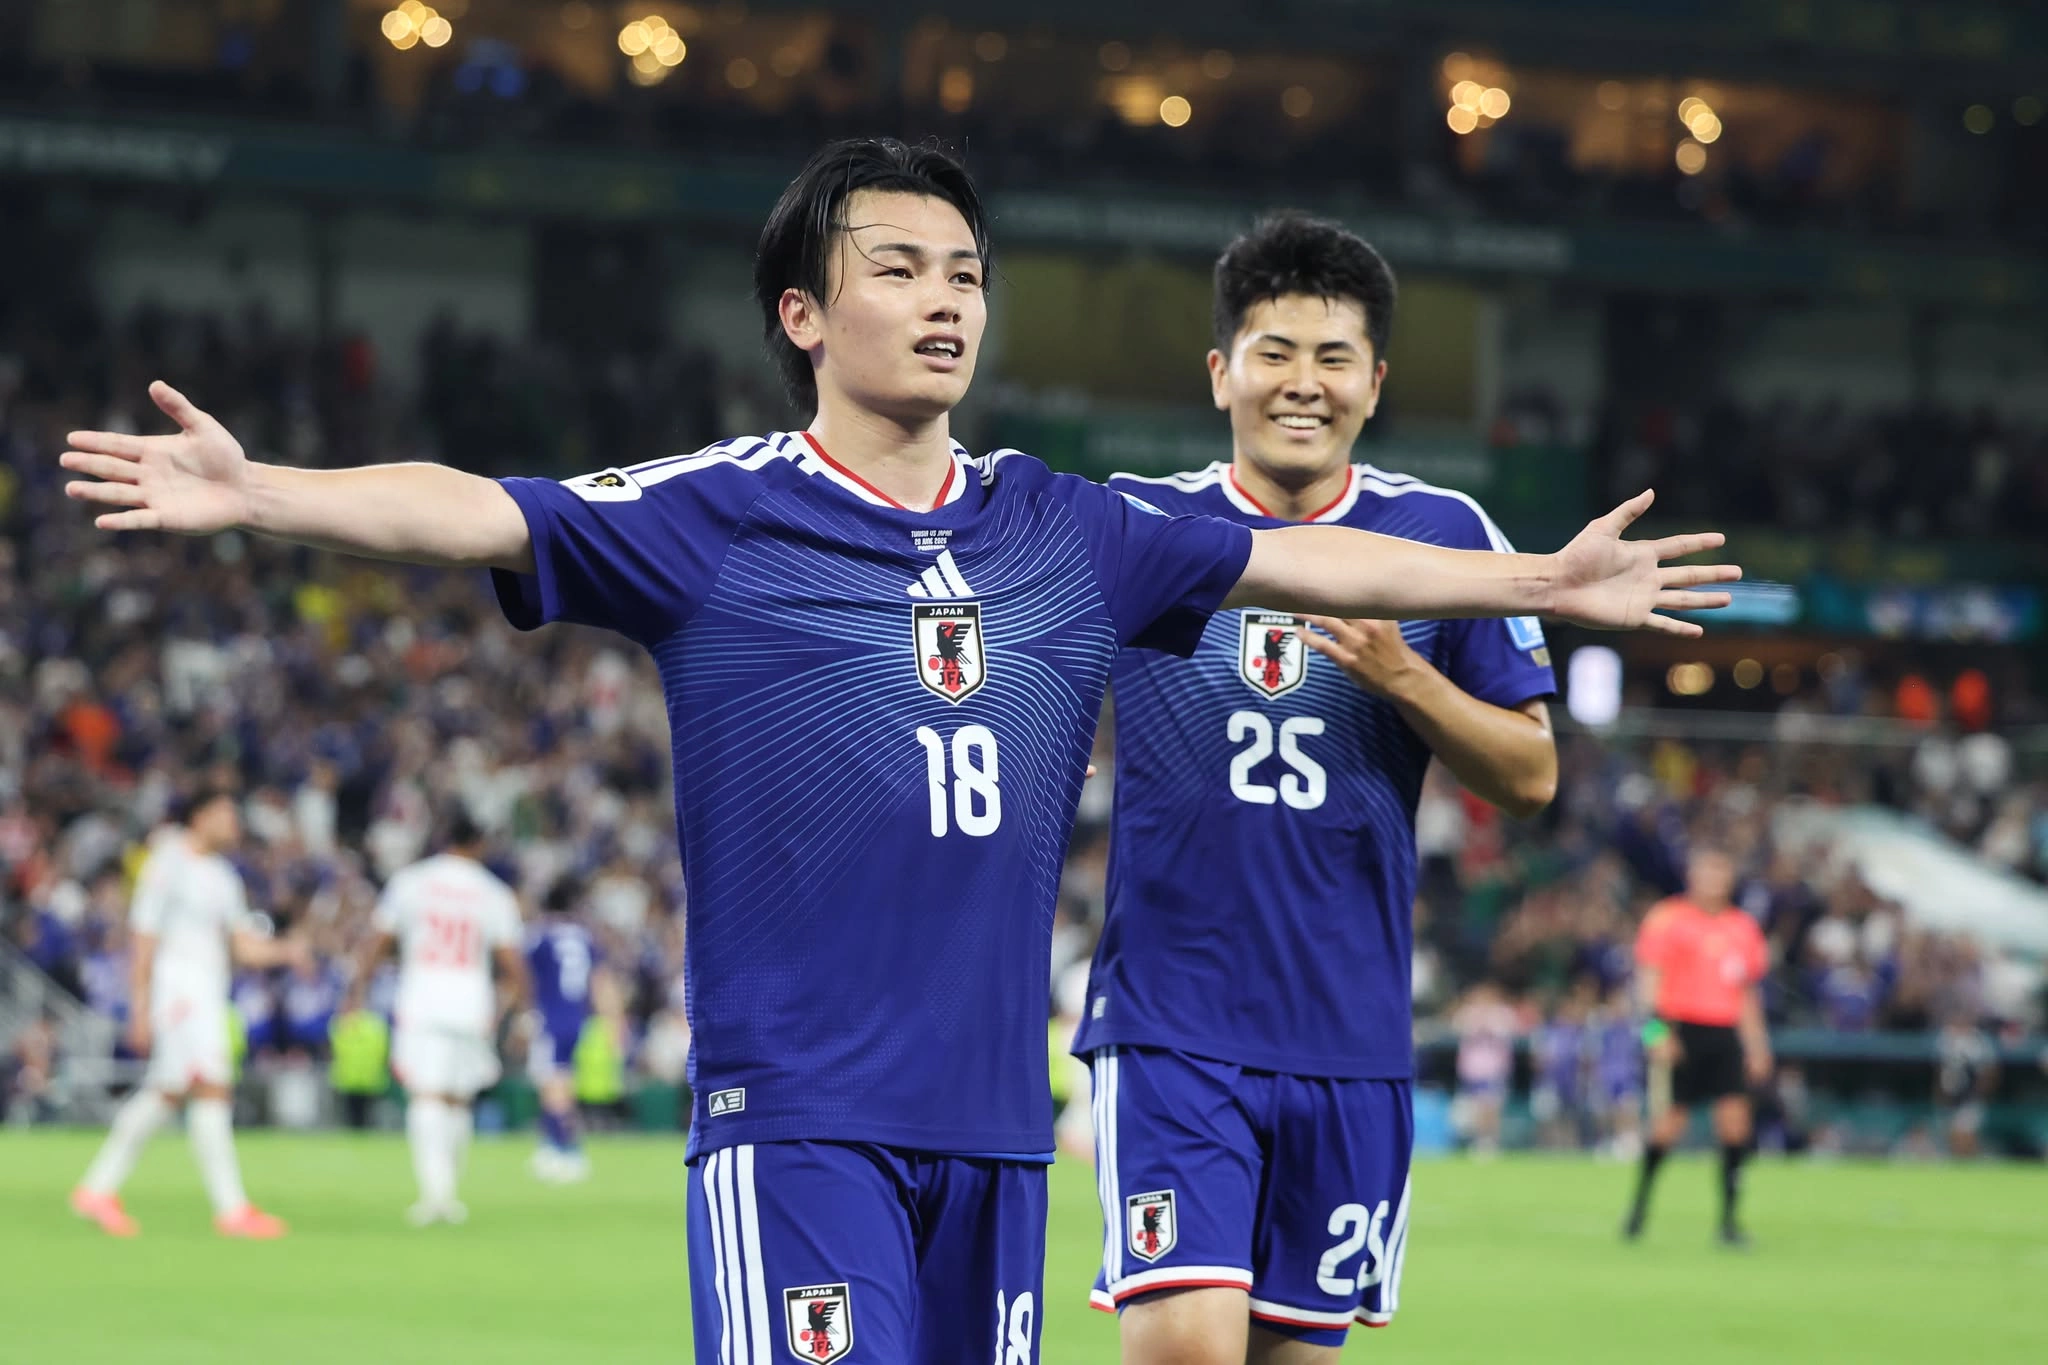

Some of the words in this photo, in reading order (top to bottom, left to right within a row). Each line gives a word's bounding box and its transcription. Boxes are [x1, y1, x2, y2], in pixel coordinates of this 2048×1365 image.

[929, 607, 964, 616] JAPAN
[938, 671, 968, 686] JFA
[1227, 710, 1327, 810] 25
[916, 724, 1001, 838] 18
[1316, 1199, 1389, 1296] 25
[800, 1287, 833, 1298] JAPAN
[807, 1340, 835, 1354] JFA
